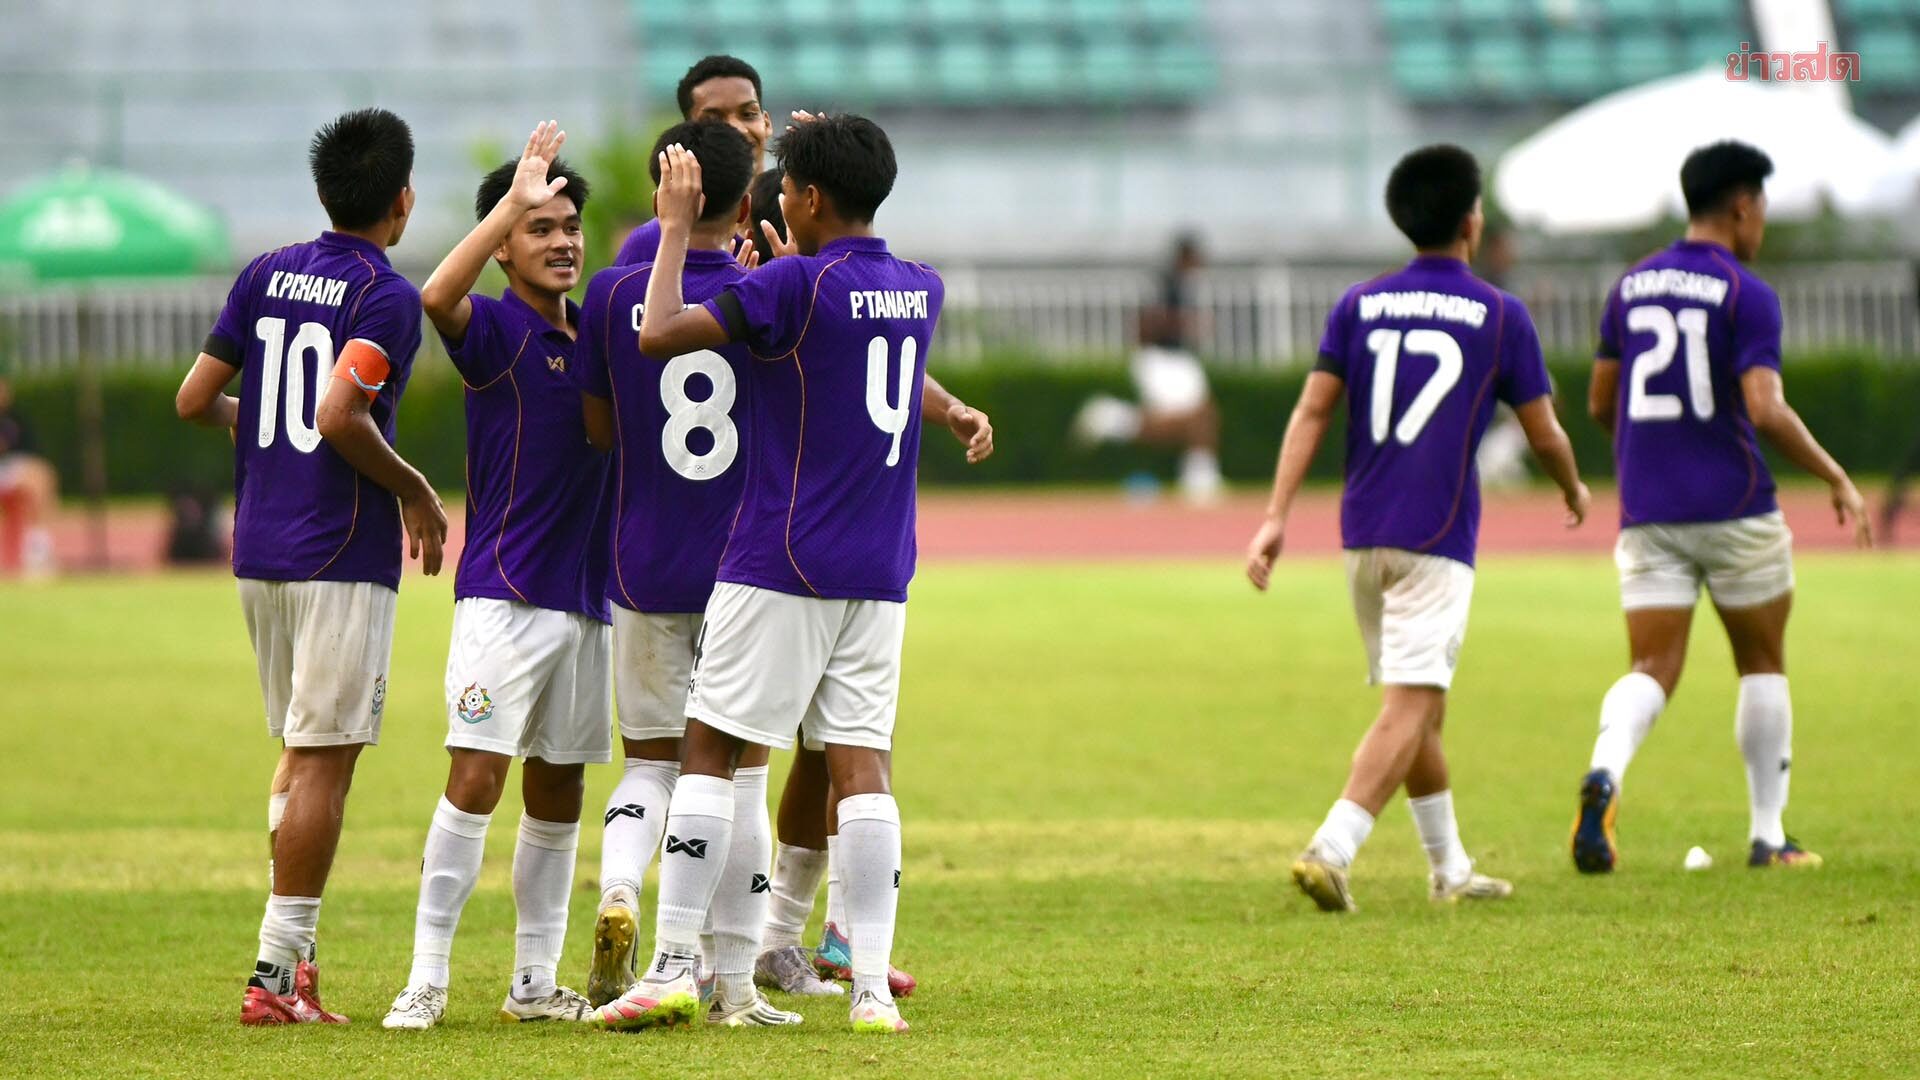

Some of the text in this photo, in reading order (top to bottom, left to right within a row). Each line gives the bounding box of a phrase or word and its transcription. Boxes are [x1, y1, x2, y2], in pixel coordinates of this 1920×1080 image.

[255, 316, 335, 453] 10
[660, 349, 739, 481] 8
[866, 335, 917, 467] 4
[1366, 328, 1463, 444] 17
[1626, 304, 1715, 421] 21
